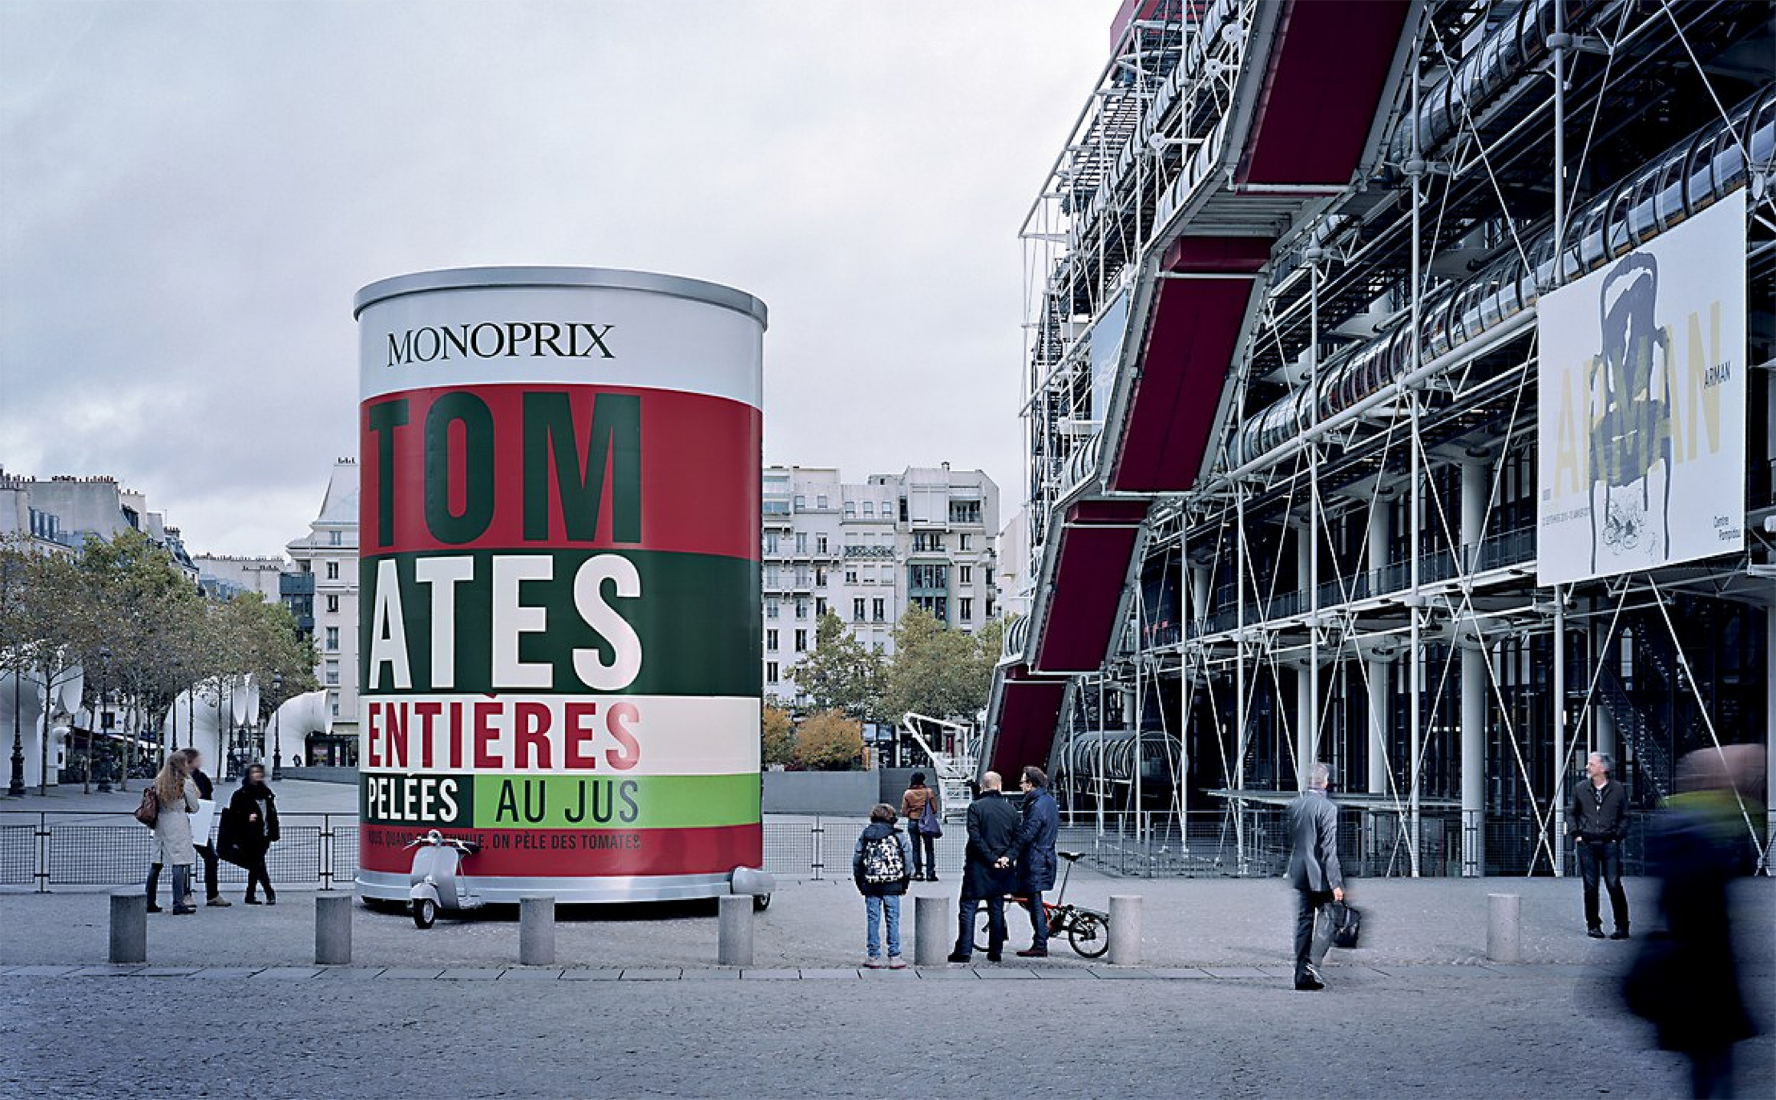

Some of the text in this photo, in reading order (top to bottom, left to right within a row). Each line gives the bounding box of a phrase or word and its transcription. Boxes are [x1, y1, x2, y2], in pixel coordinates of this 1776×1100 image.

[387, 321, 616, 368] MONOPRIX
[1704, 360, 1731, 389] ARMAN
[1554, 300, 1720, 498] ARMAN
[368, 391, 642, 547] TOM
[367, 554, 643, 691] ATES
[368, 692, 641, 771] ENTIÈRES
[368, 774, 639, 823] PELÉES AU JUS
[492, 833, 510, 849] ON
[515, 831, 546, 850] PÈLE
[551, 834, 577, 850] DES
[582, 834, 641, 850] TOMATES
